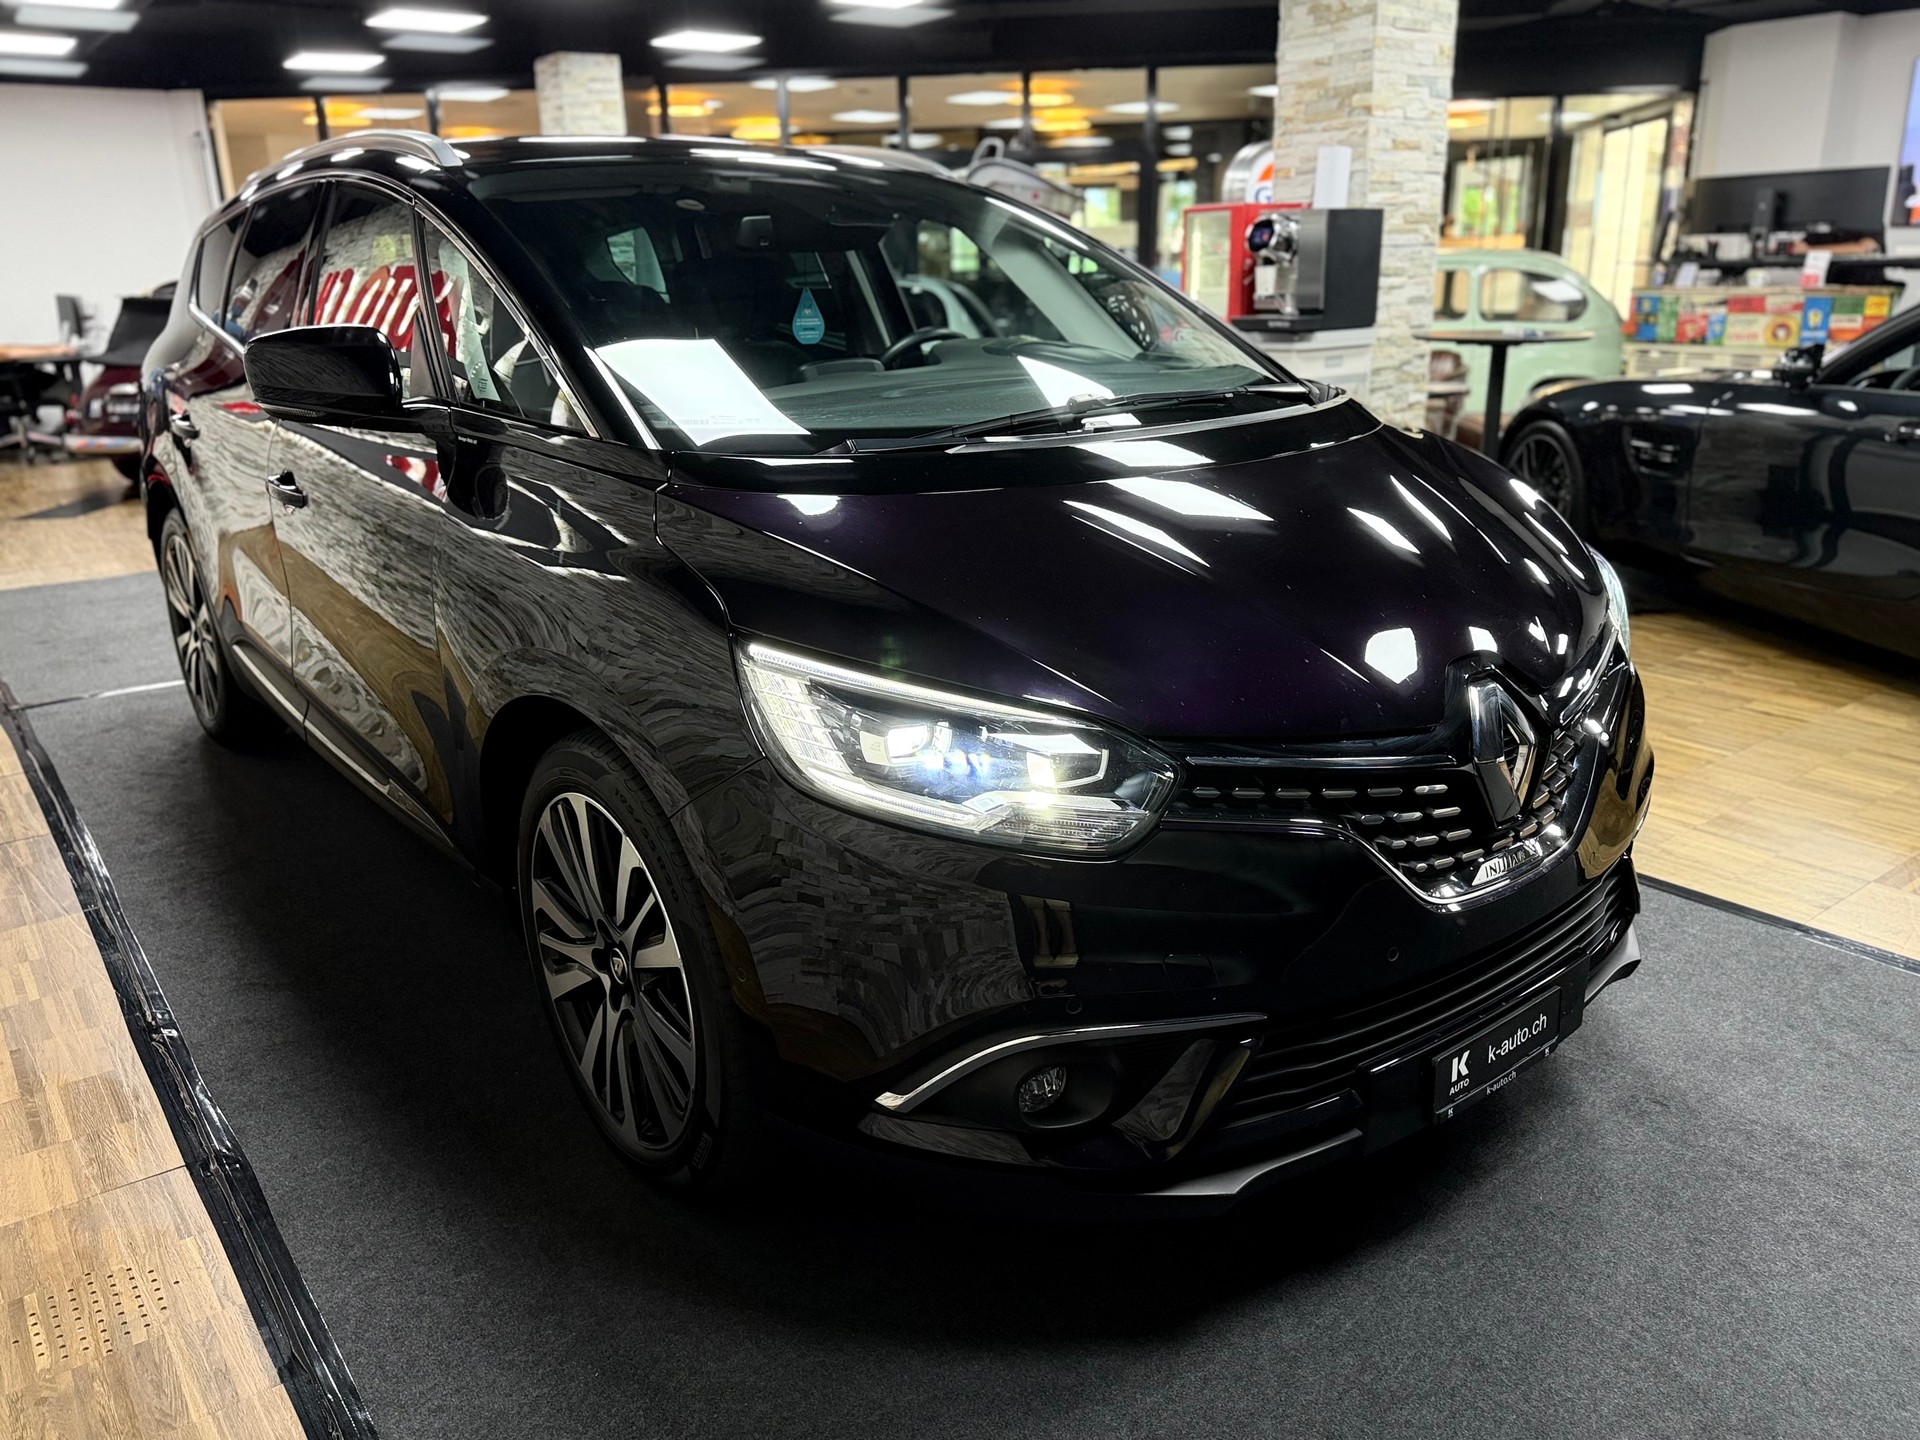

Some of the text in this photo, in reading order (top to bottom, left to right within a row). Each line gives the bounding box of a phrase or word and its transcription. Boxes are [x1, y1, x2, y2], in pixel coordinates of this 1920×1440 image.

[1487, 1013, 1547, 1064] k-auto.ch
[1451, 1050, 1470, 1083] K
[1449, 1078, 1470, 1096] AUTO
[1486, 1070, 1517, 1095] k-auto.ch
